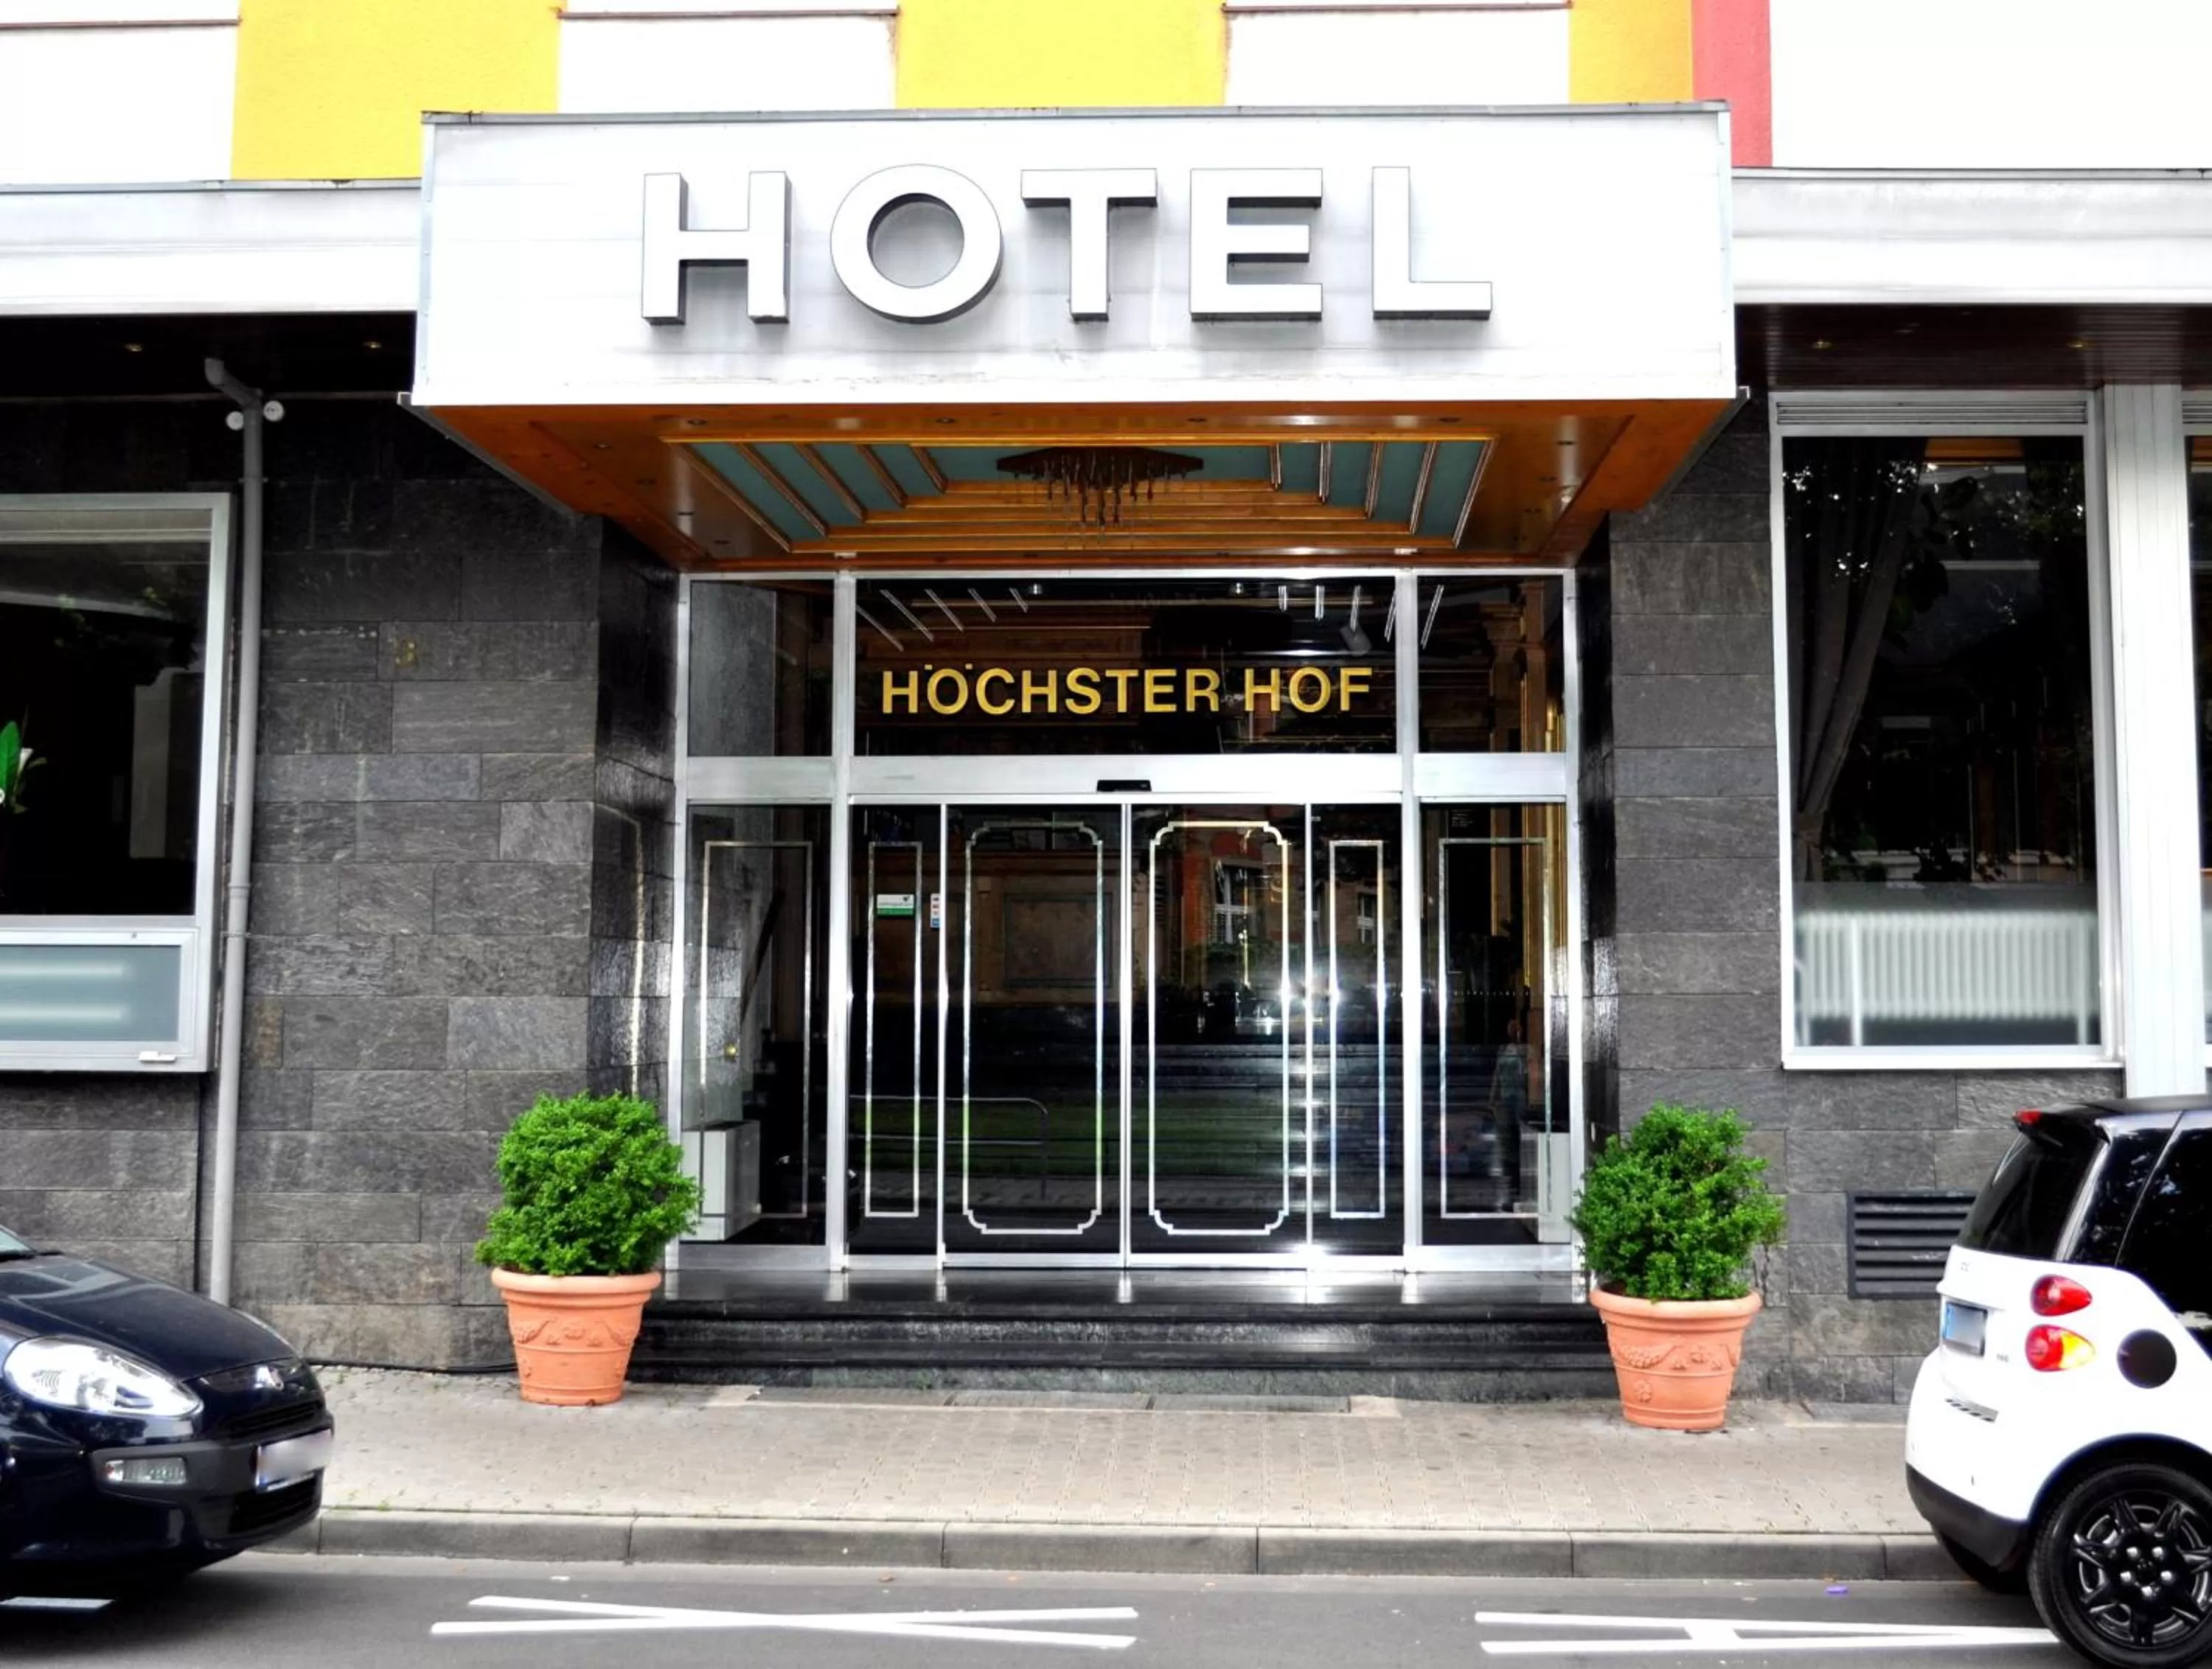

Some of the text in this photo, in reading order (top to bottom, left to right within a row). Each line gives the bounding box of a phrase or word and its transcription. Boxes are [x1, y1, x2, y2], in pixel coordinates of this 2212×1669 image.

[640, 164, 1493, 325] HOTEL
[882, 663, 1373, 714] HÖCHSTER HOF
